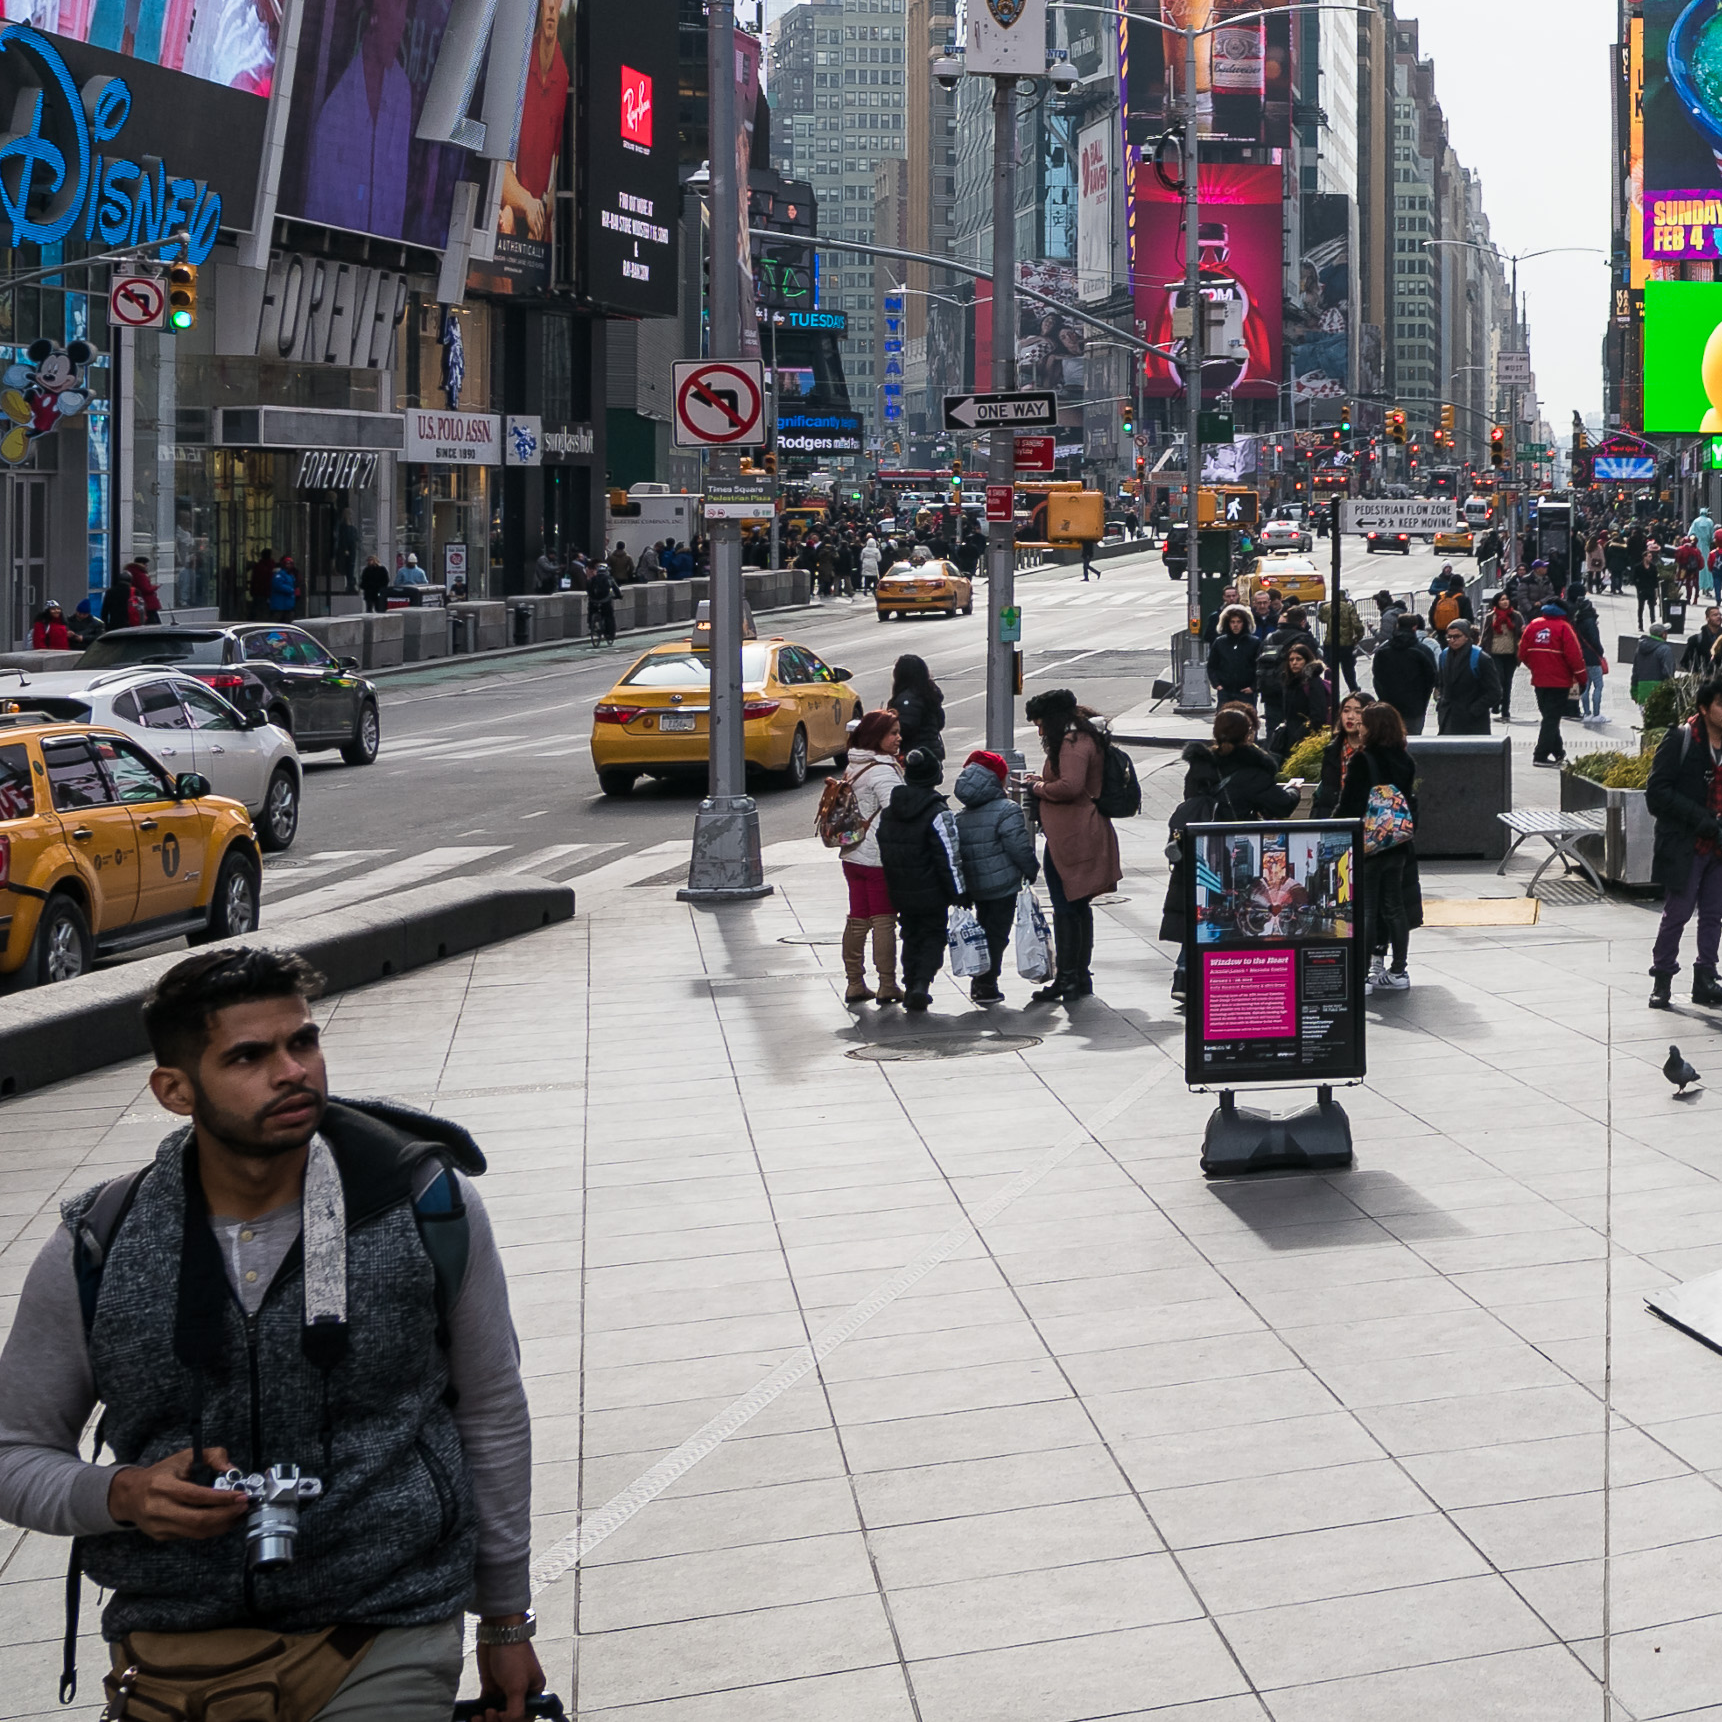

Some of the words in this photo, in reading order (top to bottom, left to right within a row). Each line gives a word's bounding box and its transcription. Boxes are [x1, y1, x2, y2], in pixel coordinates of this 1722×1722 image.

[0, 24, 223, 267] Disney
[1653, 226, 1686, 251] FEB
[1690, 224, 1704, 251] 4
[976, 404, 1008, 419] ONE
[1012, 401, 1046, 418] WAY
[417, 415, 437, 440] U.S.
[437, 417, 464, 442] POLO
[464, 420, 492, 444] ASSN.
[777, 435, 832, 452] Rodgers
[296, 451, 359, 490] FOREVER
[707, 485, 733, 494] Times
[734, 485, 764, 495] Square
[1354, 504, 1404, 516] PEDESTRIAN
[1406, 504, 1429, 515] FLOW
[1430, 504, 1453, 516] ZONE
[1398, 518, 1422, 528] KEEP
[1423, 517, 1453, 528] MOVING
